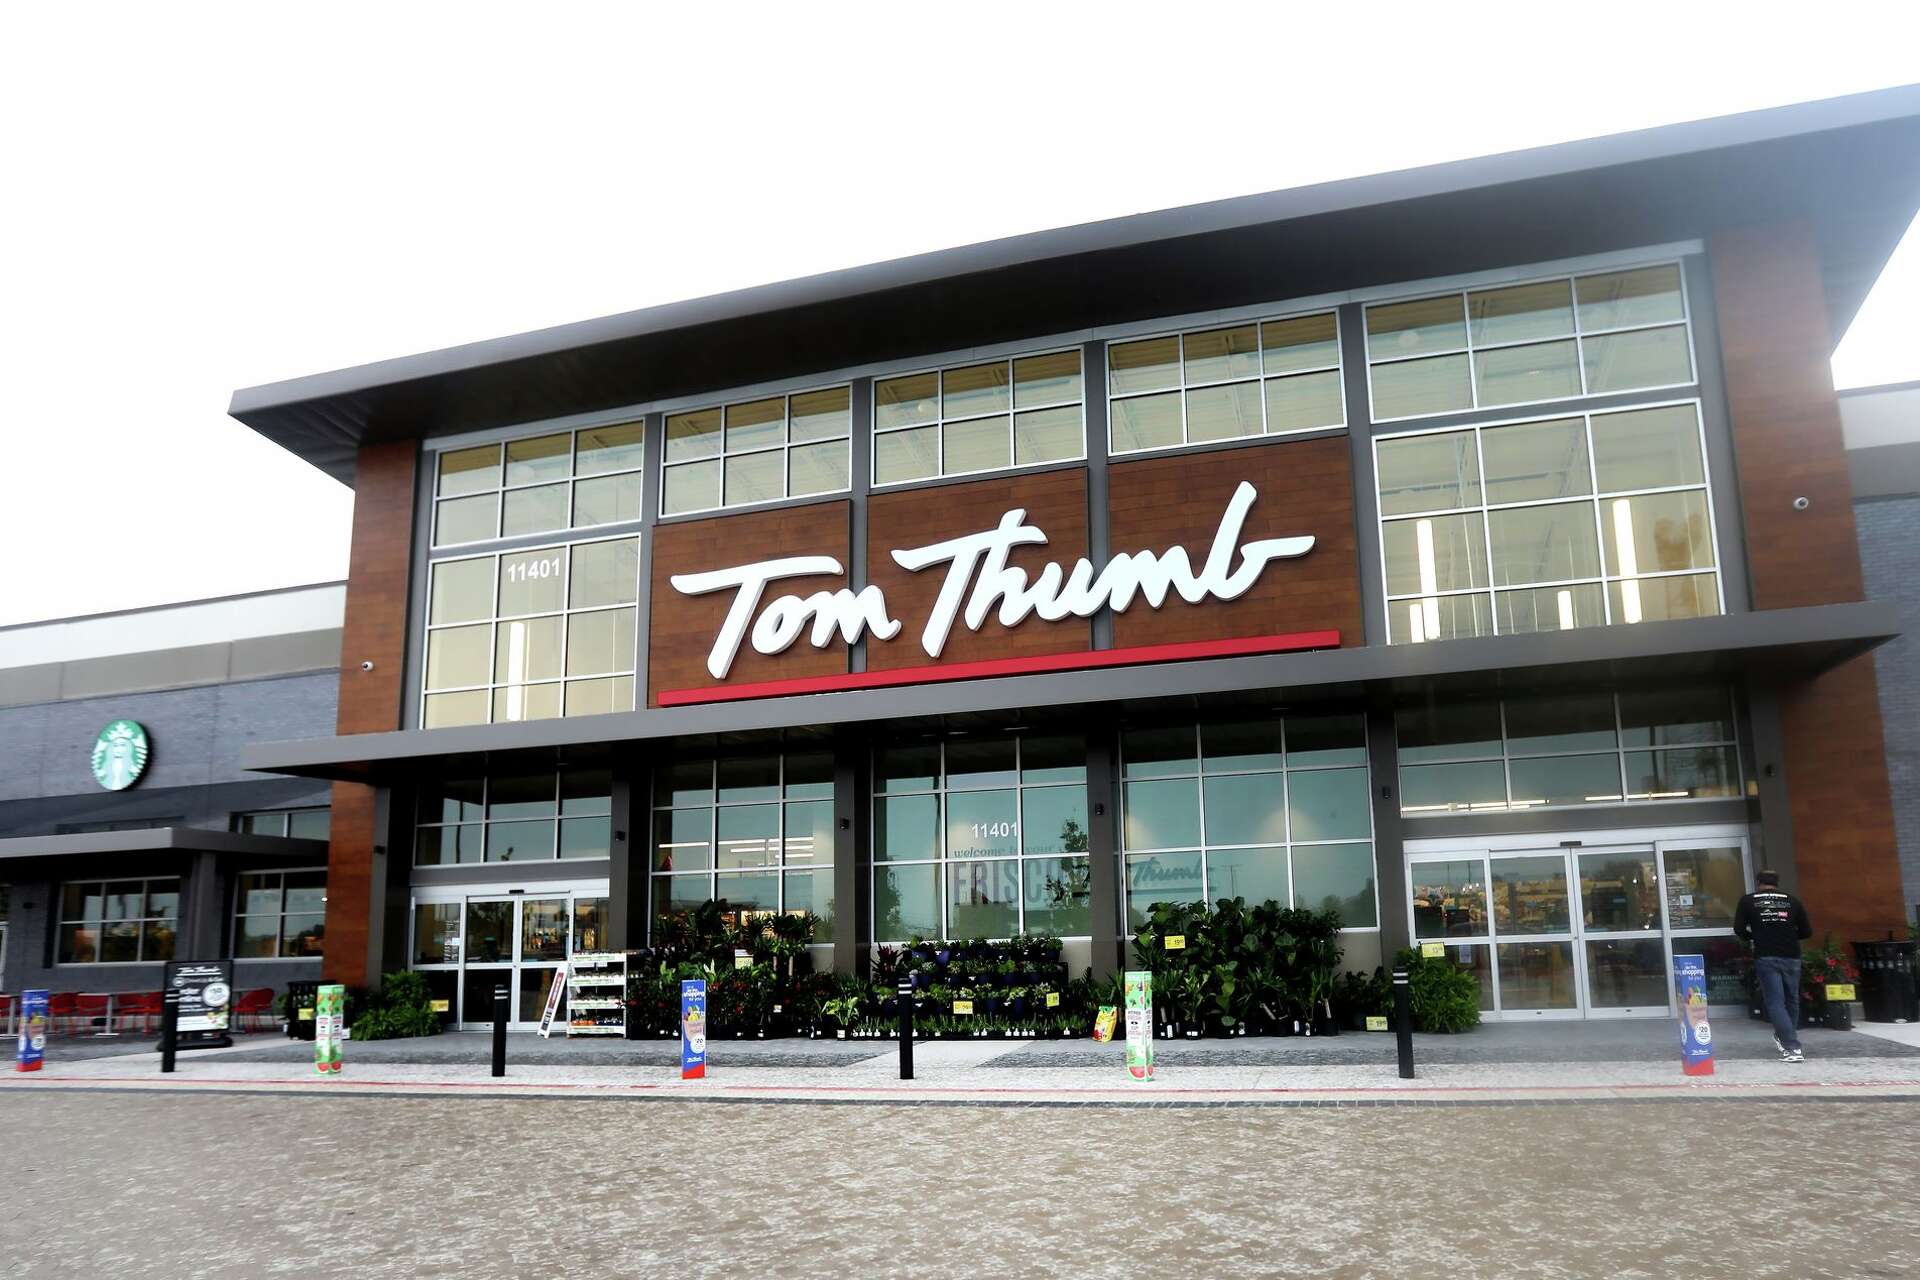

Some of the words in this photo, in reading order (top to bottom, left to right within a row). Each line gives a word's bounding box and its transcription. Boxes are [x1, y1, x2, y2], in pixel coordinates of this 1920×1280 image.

[508, 558, 560, 582] 11401
[670, 555, 901, 679] Tom
[890, 480, 1316, 659] Thumb
[971, 822, 1018, 839] 11401
